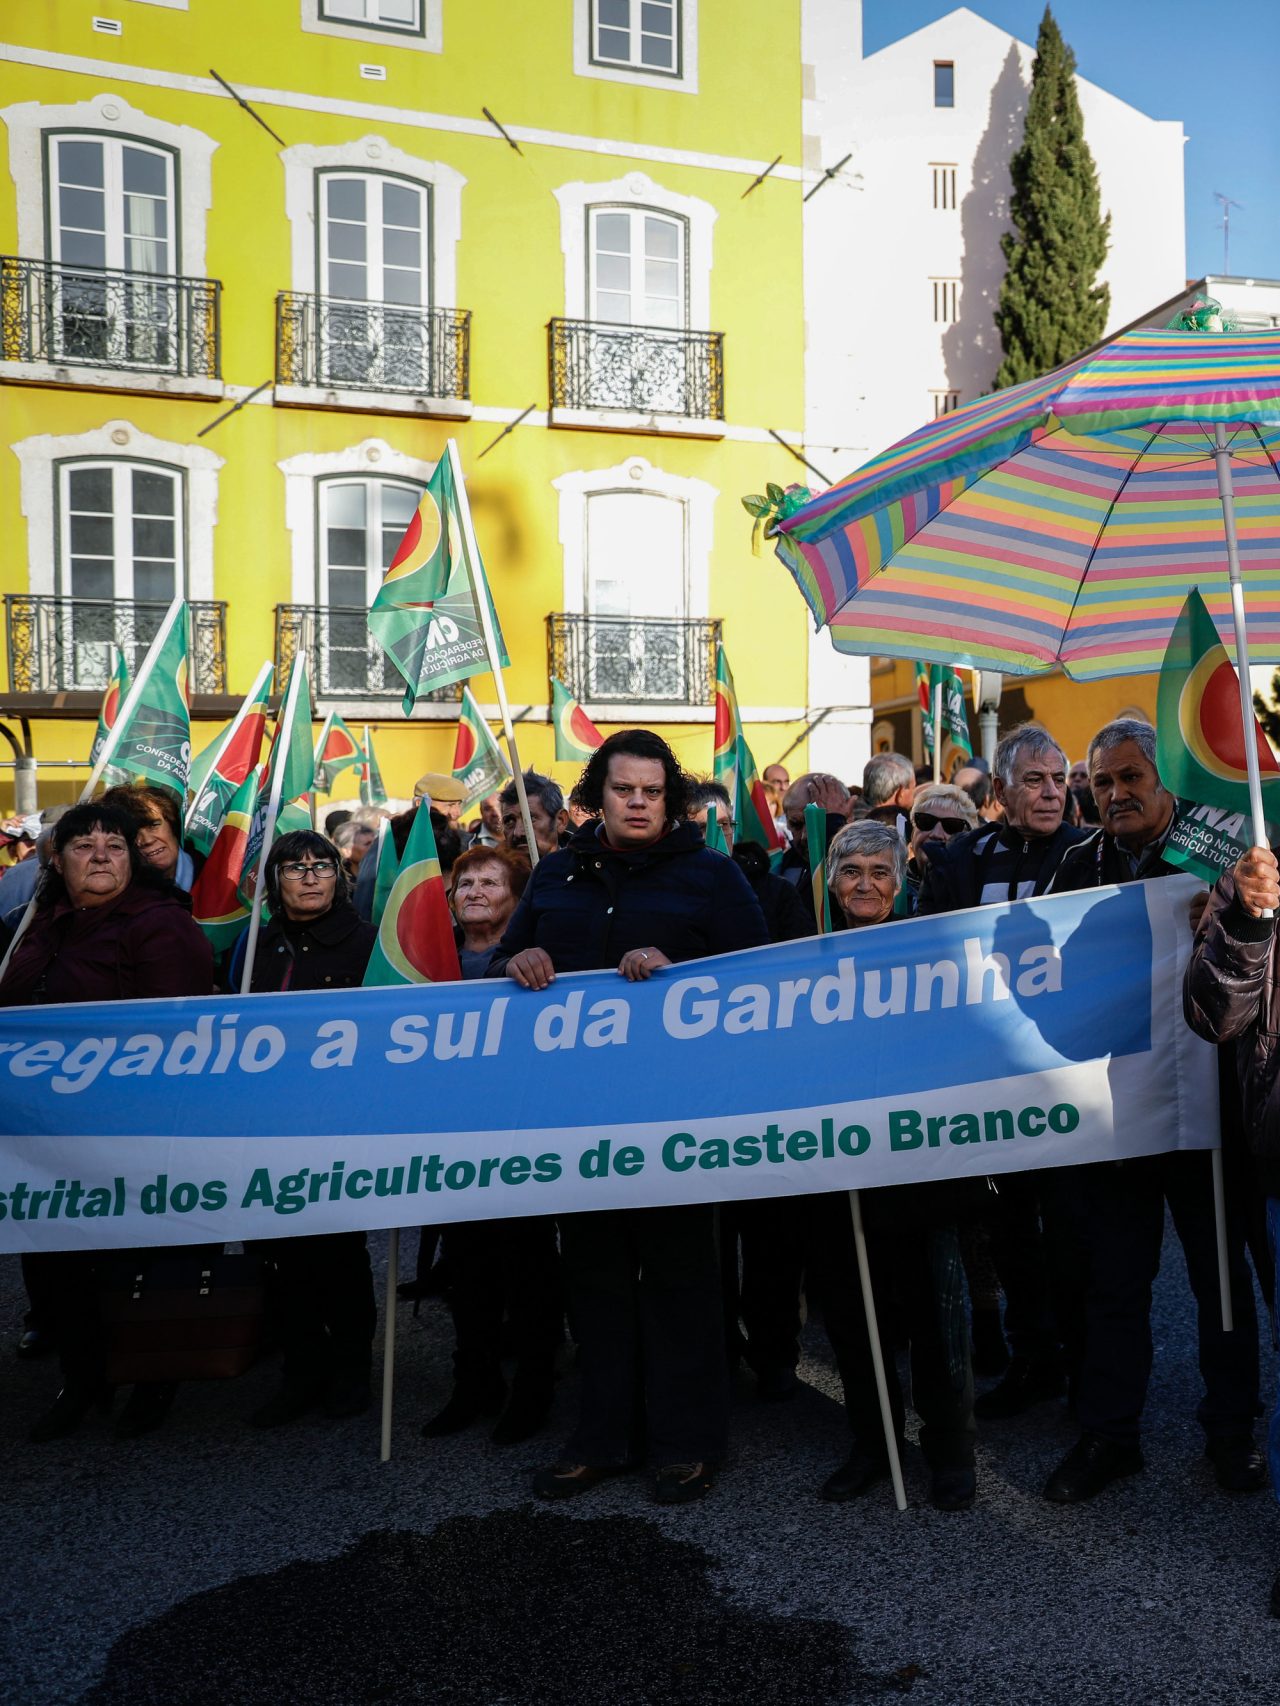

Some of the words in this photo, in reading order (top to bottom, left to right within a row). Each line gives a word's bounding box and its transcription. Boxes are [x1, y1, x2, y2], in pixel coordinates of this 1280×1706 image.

[1213, 838, 1247, 860] NACI
[311, 1019, 358, 1069] a
[385, 996, 510, 1064] sul
[533, 990, 630, 1052] da
[662, 936, 1063, 1040] Gardunha
[0, 1176, 126, 1221] trital
[140, 1174, 228, 1215] dos
[242, 1154, 562, 1215] Agricultores
[579, 1139, 645, 1179] de
[661, 1118, 871, 1173] Castelo
[888, 1102, 1081, 1152] Branco
